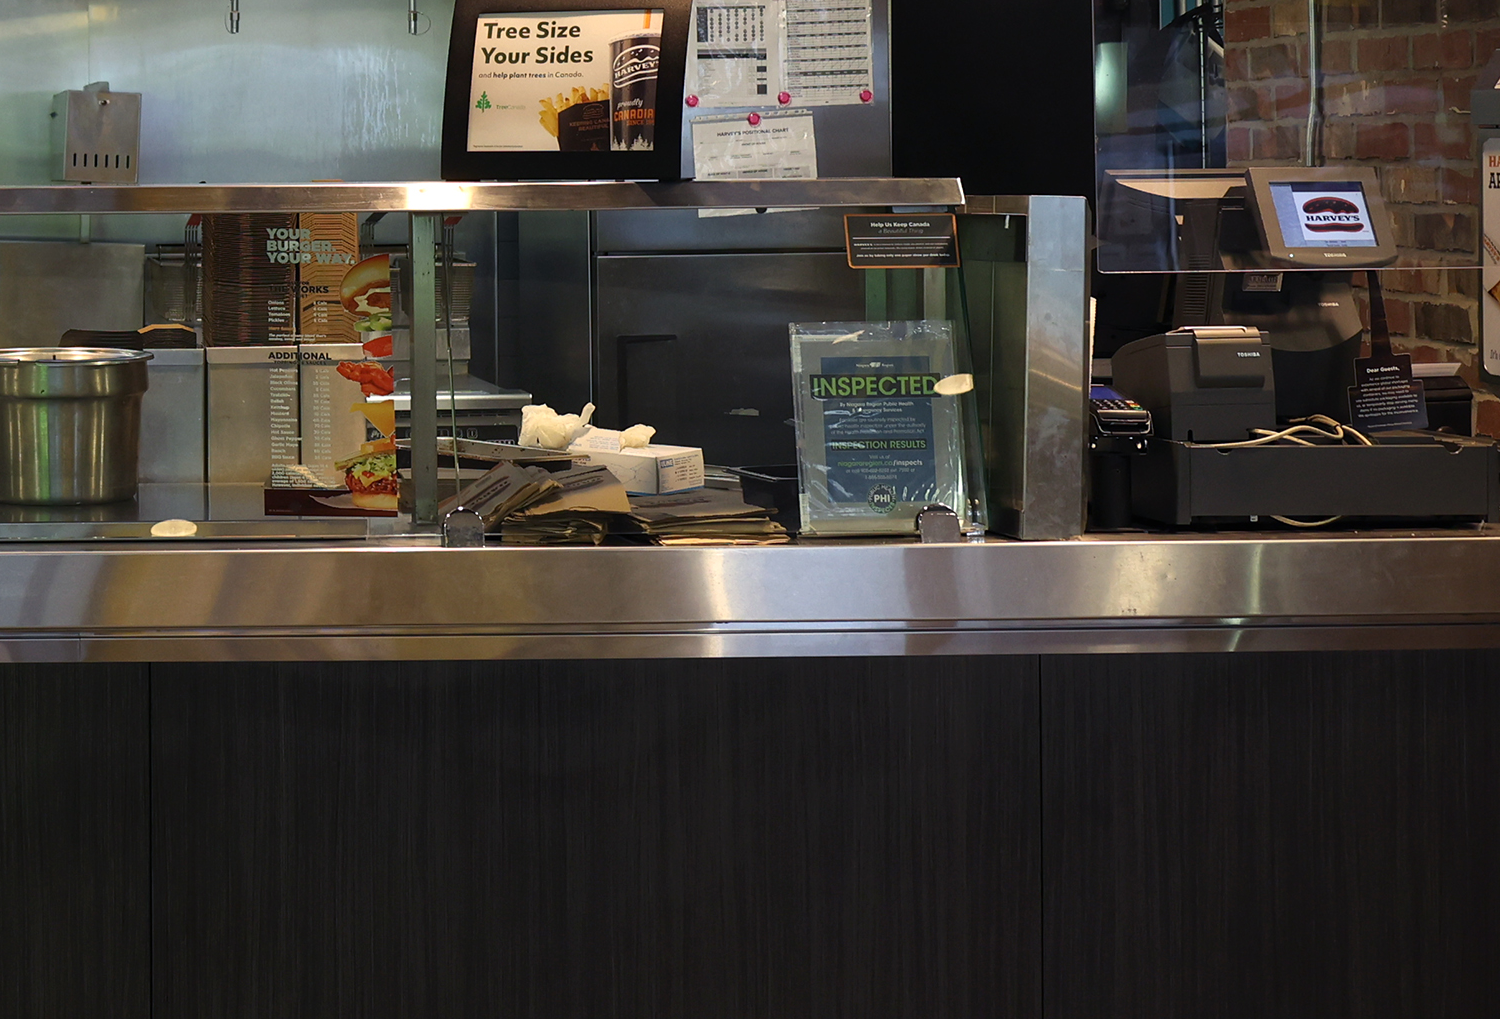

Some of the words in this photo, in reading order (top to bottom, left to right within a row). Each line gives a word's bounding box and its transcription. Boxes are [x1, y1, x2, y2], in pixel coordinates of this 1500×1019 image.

[484, 23, 530, 38] Tree
[536, 21, 580, 38] Size
[481, 47, 530, 64] Your
[536, 47, 593, 63] Sides
[617, 98, 643, 110] proudly
[266, 229, 311, 239] YOUR
[267, 241, 336, 251] BURGER.
[266, 253, 311, 263] YOUR
[316, 253, 356, 264] WAY.
[268, 352, 331, 360] ADDITIONAL
[813, 376, 938, 396] INSPECTED
